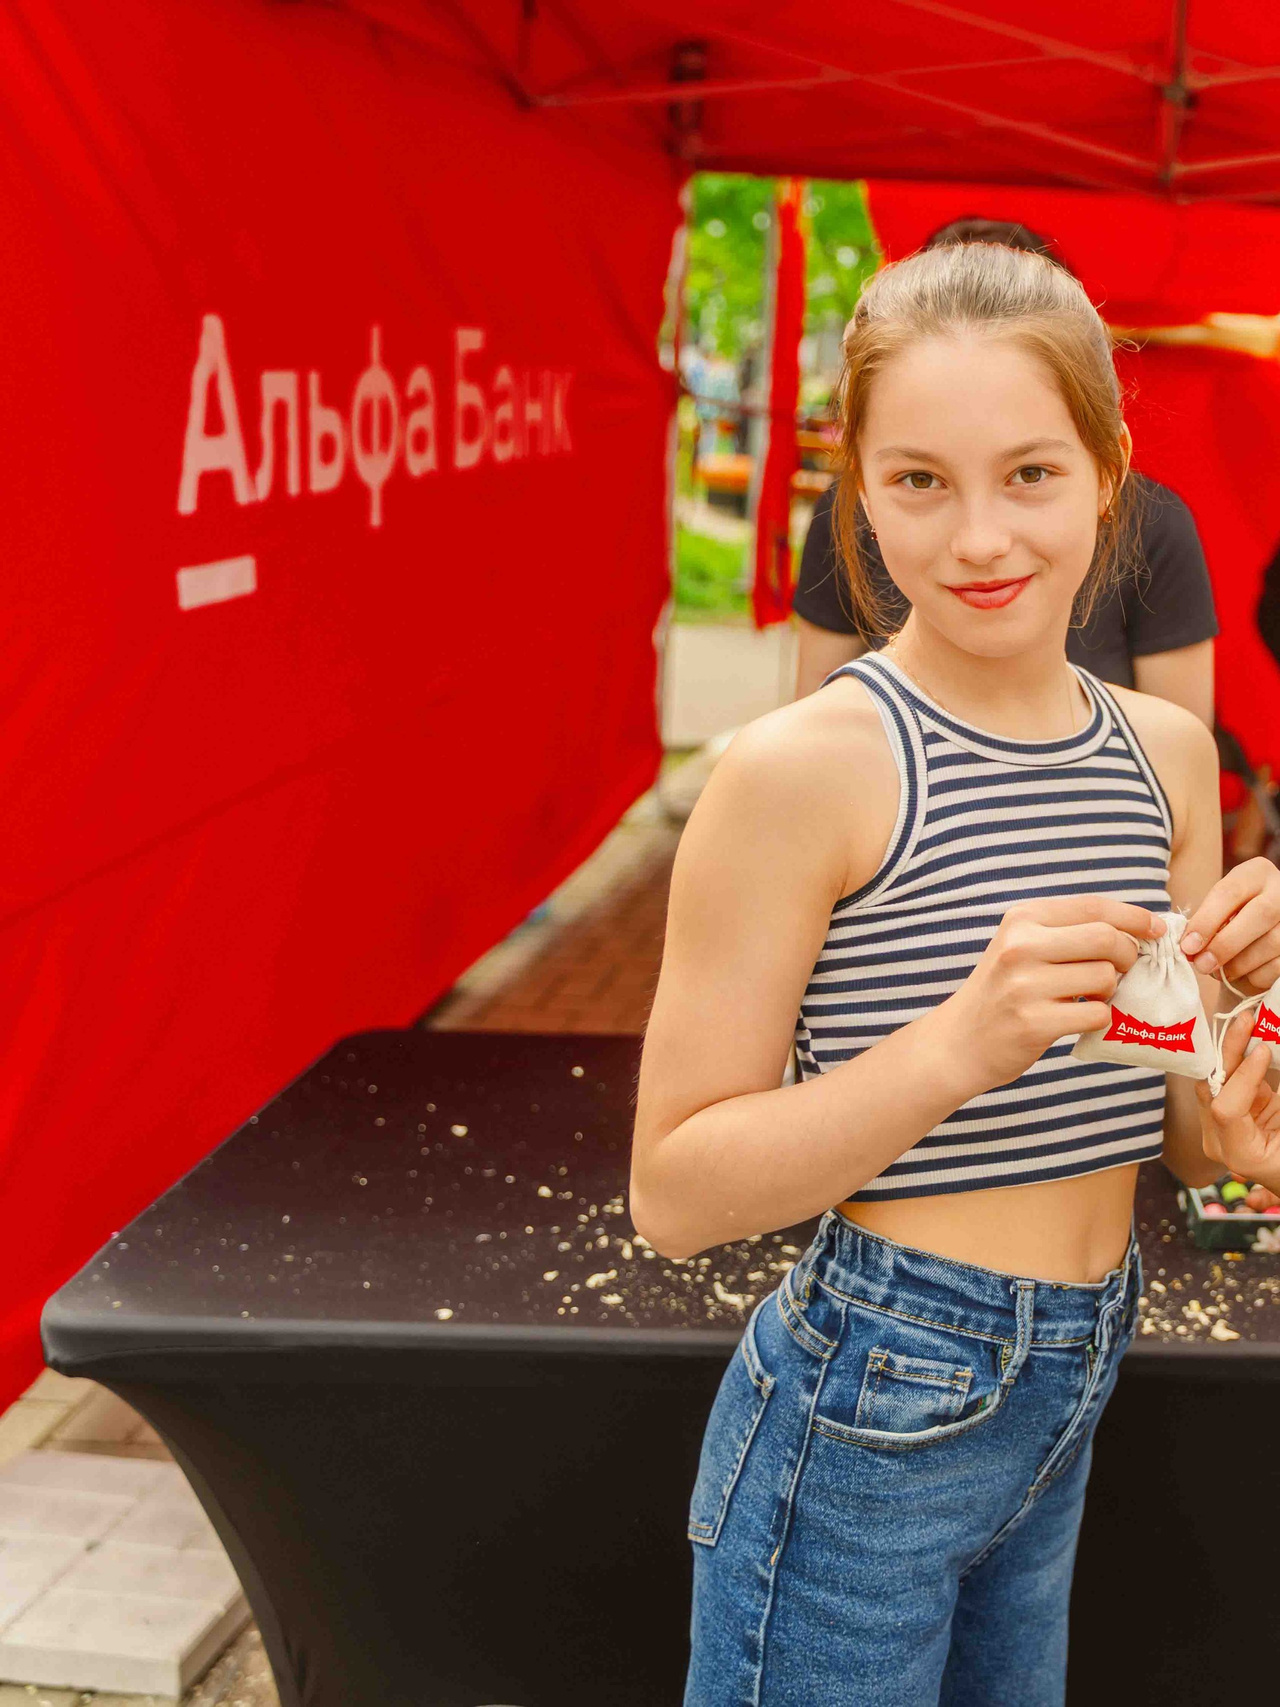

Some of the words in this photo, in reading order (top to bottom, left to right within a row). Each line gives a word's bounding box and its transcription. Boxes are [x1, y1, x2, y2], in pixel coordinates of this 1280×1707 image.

[177, 314, 437, 527] Альфа
[454, 326, 572, 469] Банк
[1117, 1022, 1156, 1039] Альфа
[1157, 1032, 1187, 1041] Банк
